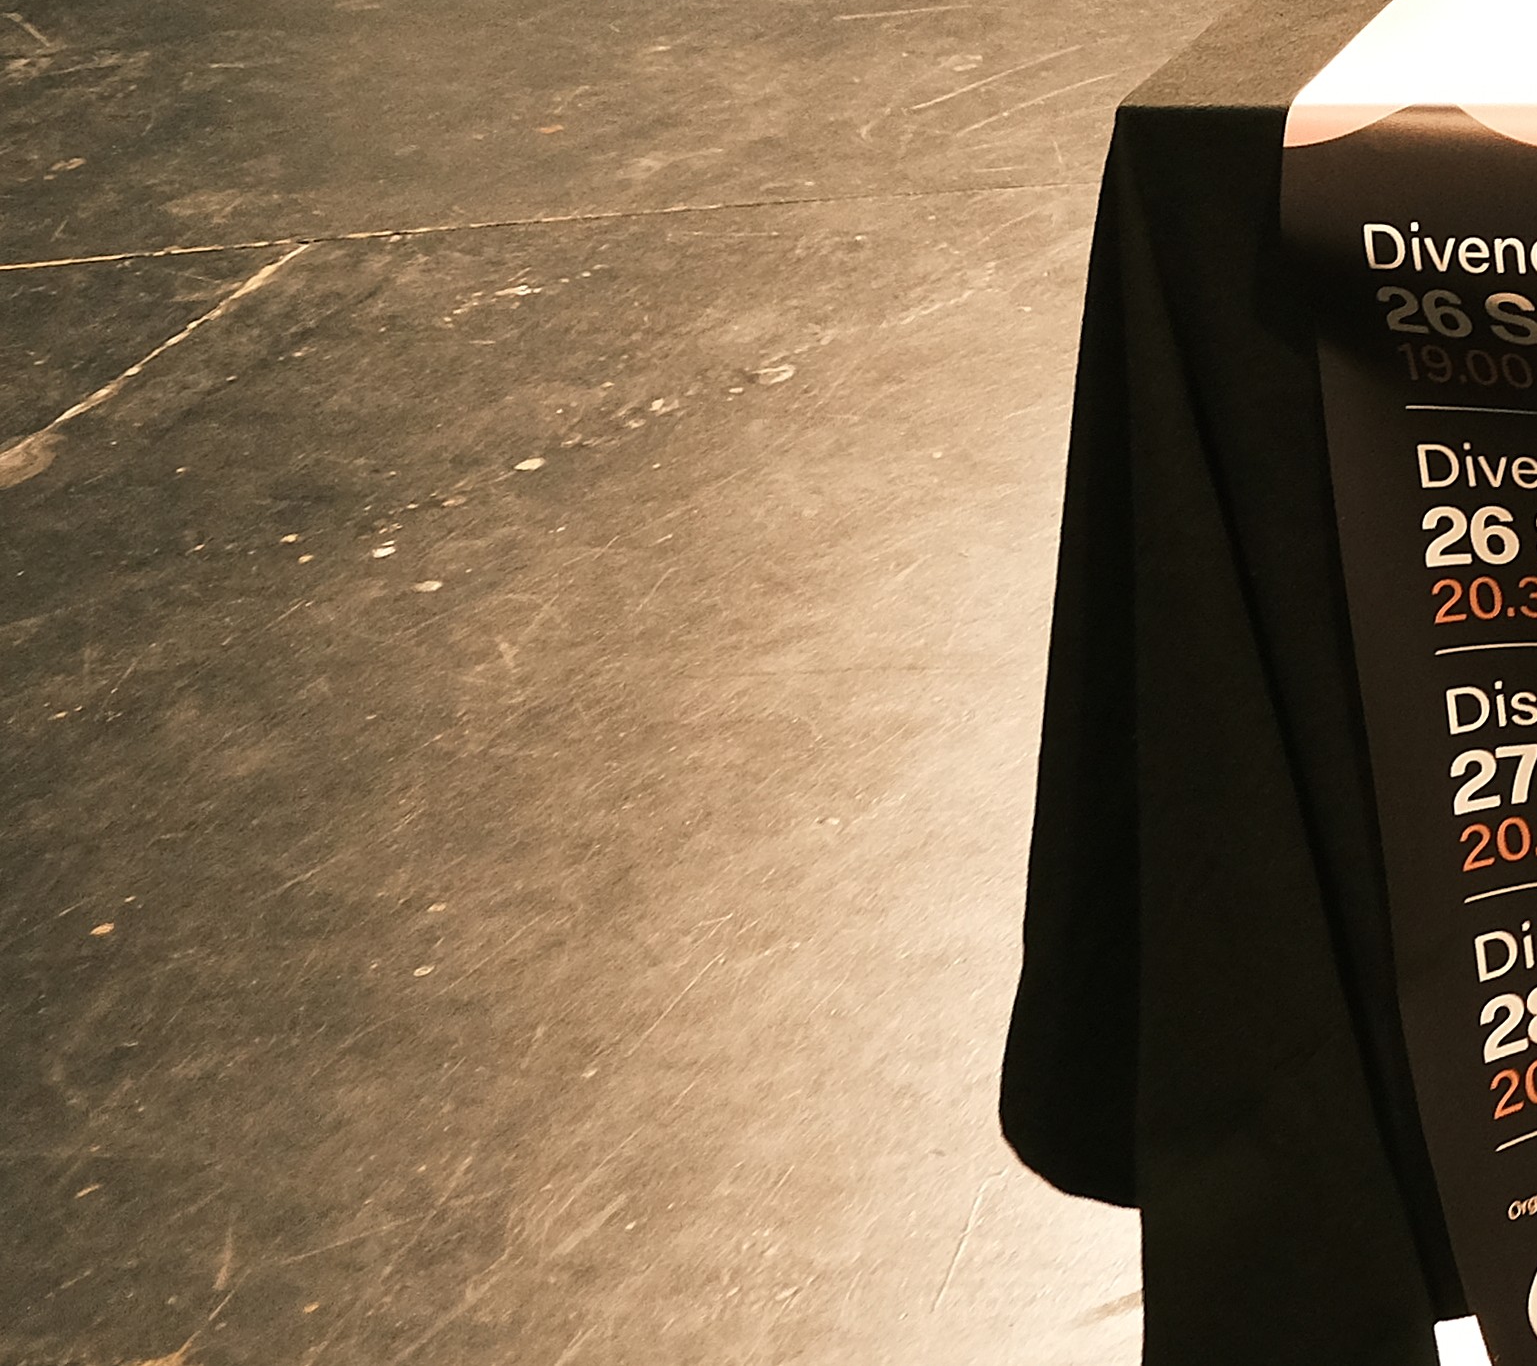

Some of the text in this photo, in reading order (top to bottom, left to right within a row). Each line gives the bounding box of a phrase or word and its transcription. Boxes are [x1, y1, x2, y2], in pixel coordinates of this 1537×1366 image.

[1374, 283, 1474, 341] 26
[1396, 340, 1535, 393] 19.00
[1421, 505, 1521, 569] 26
